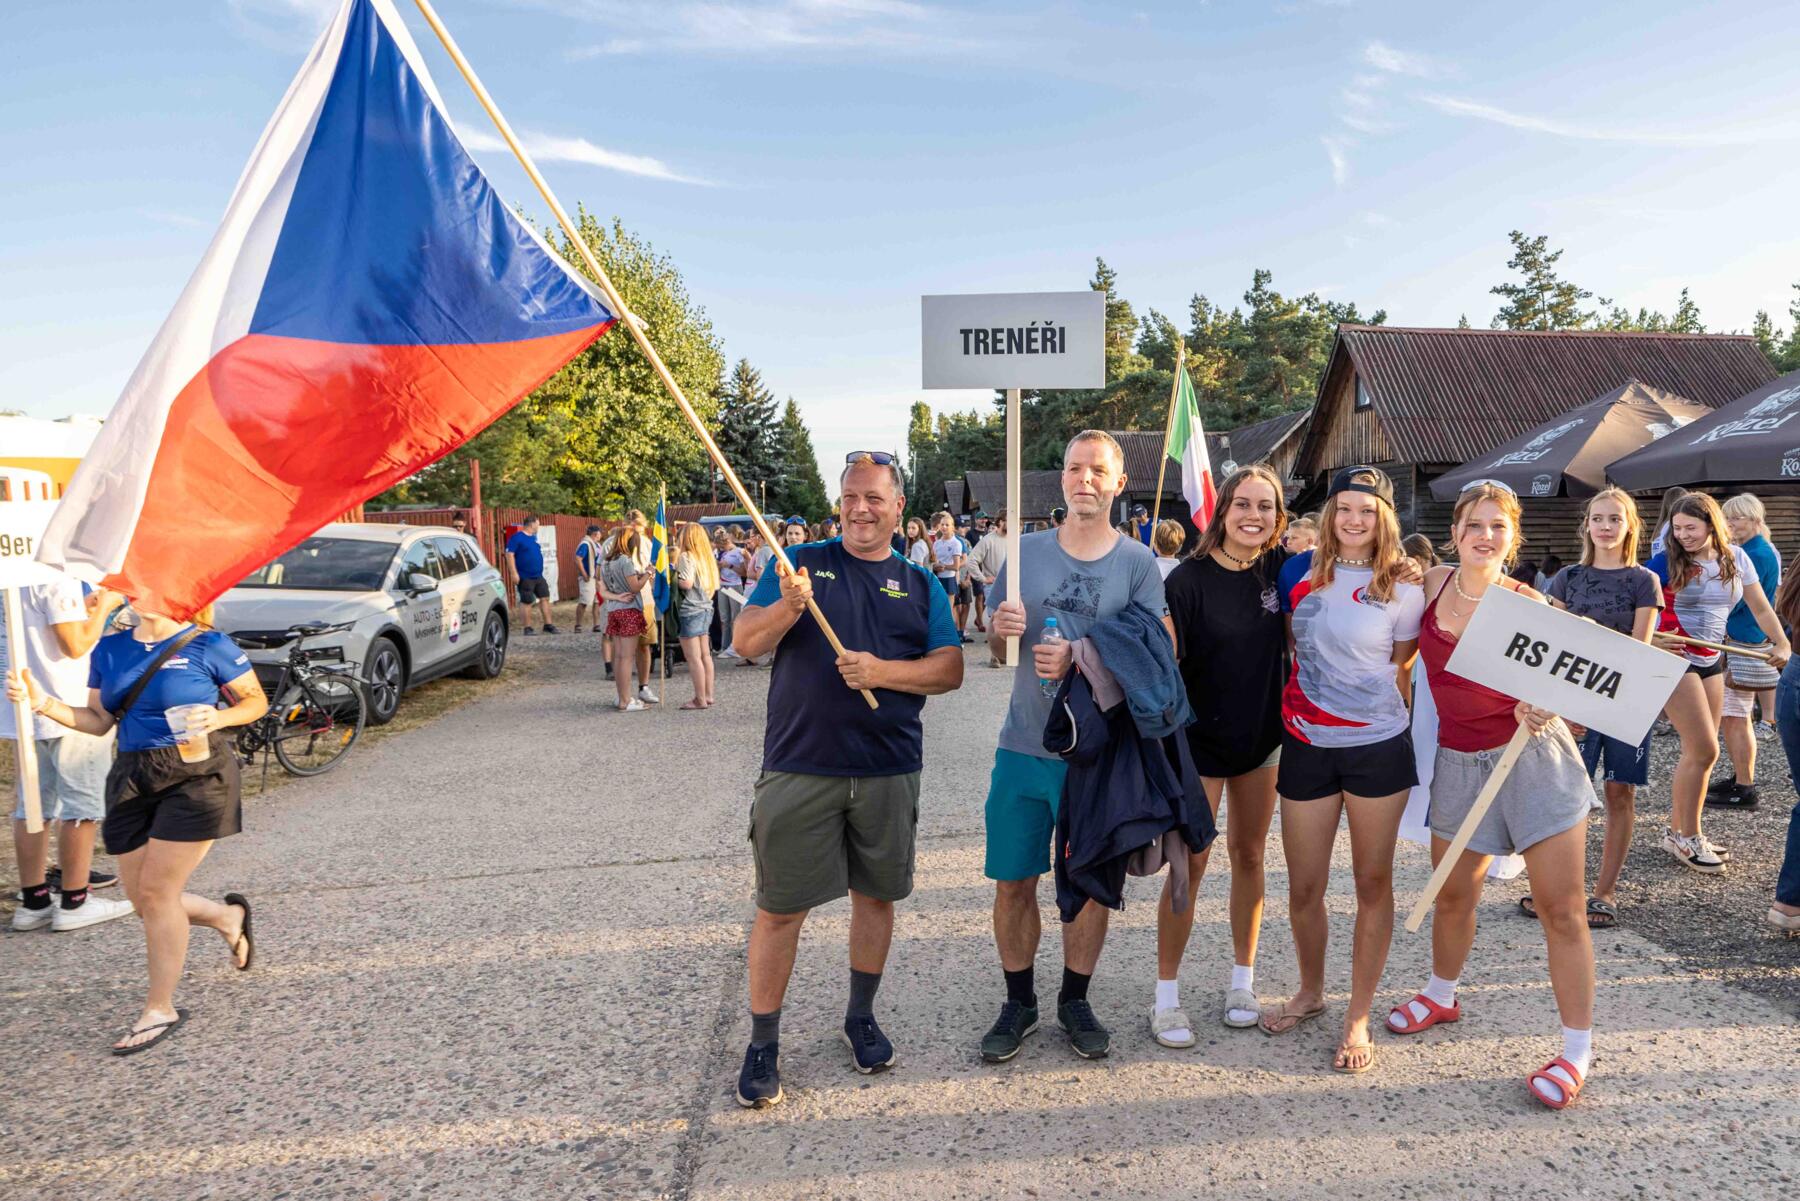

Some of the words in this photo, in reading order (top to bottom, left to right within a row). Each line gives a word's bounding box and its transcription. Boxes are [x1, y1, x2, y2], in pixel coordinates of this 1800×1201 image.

[959, 321, 1066, 355] TRENÉŘI
[1780, 457, 1800, 477] Ko
[1531, 481, 1552, 495] Kozel
[413, 610, 431, 624] AUTO
[1504, 631, 1549, 668] RS
[1549, 649, 1622, 700] FEVA
